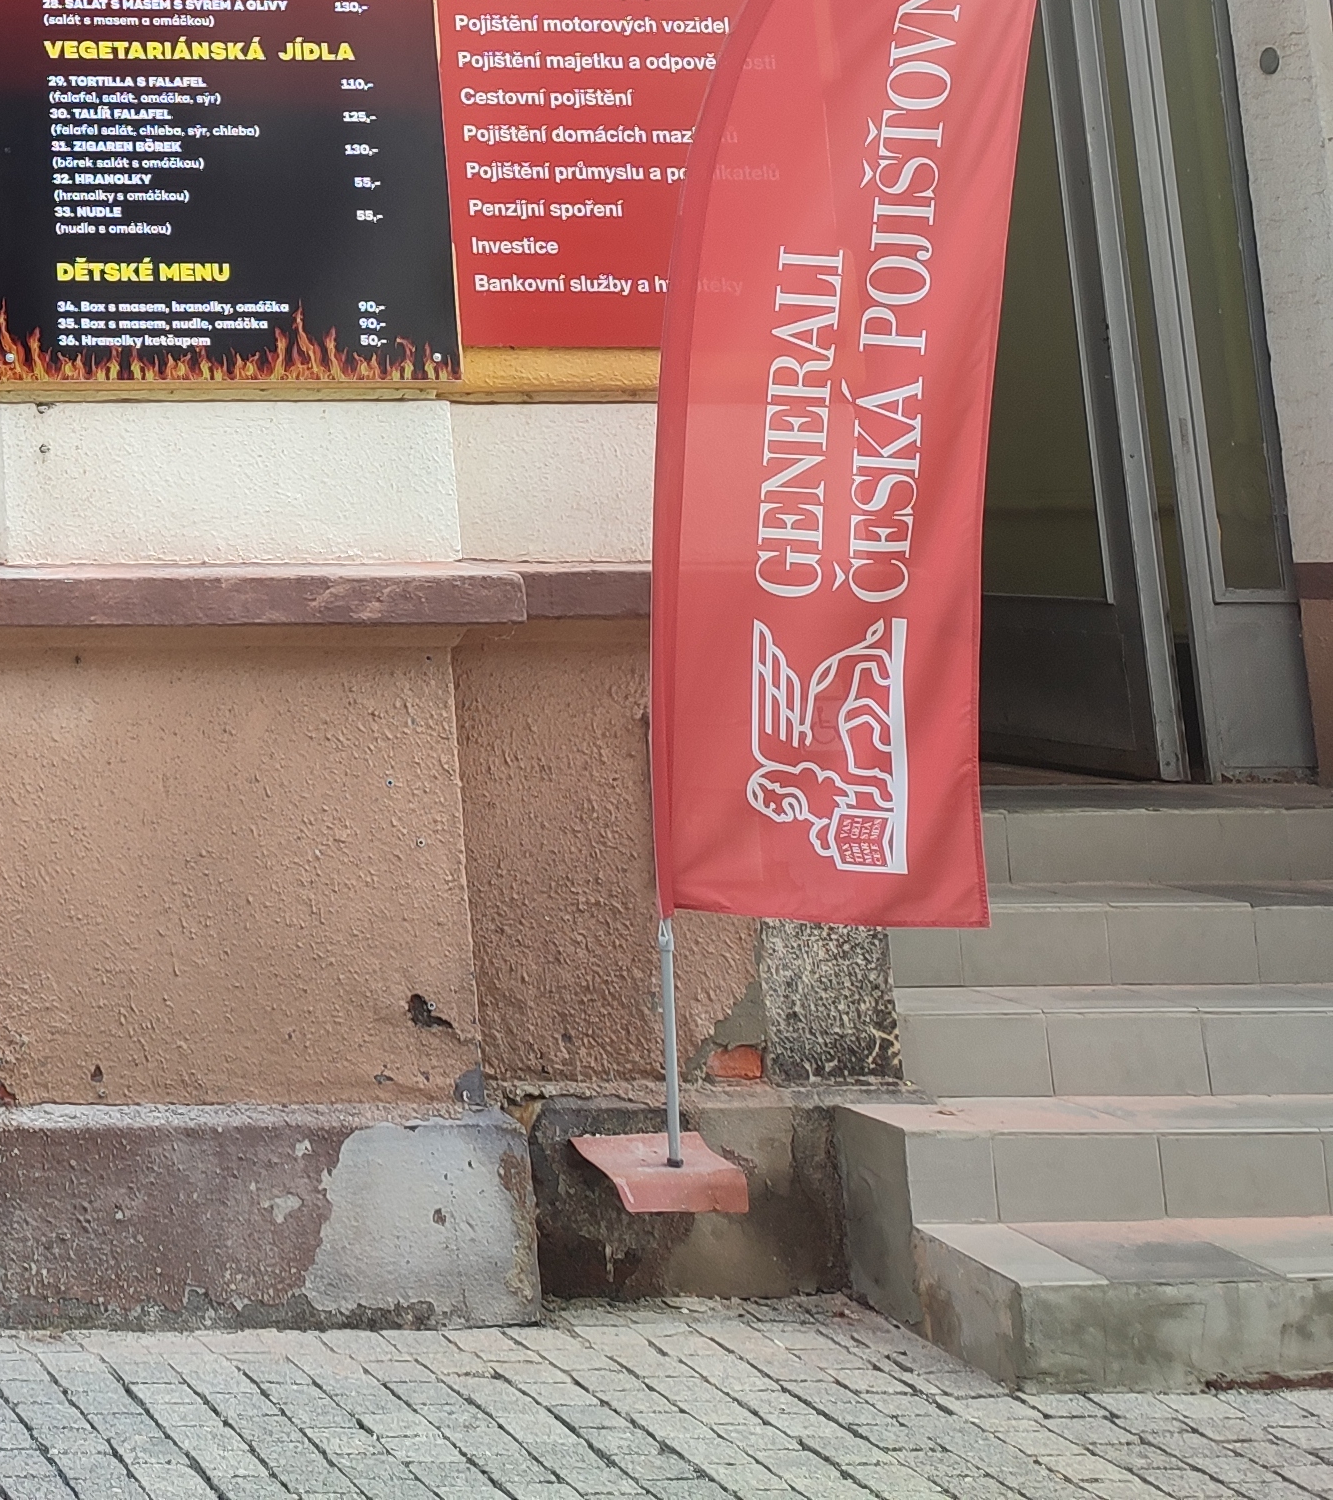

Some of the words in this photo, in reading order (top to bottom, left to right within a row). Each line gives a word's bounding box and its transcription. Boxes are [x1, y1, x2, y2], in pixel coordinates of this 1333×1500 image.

[454, 14, 539, 35] Pojištění
[543, 16, 657, 35] motorových
[661, 17, 730, 34] vozidel
[43, 37, 267, 60] VEGETARIÁNSKÁ
[277, 37, 356, 60] JÍDLA
[457, 52, 542, 71] Pojištění
[545, 53, 624, 71] majetku
[628, 57, 641, 68] a
[460, 88, 546, 106] Cestovní
[549, 89, 633, 108] pojištění
[463, 125, 548, 144] Pojištění
[551, 125, 647, 143] domácích
[51, 174, 73, 184] 32.
[74, 173, 152, 184] HRANOLKY
[465, 161, 550, 182] Pojištění
[554, 162, 644, 183] průmyslu
[648, 168, 662, 179] a
[468, 200, 546, 219] Penzijní
[549, 200, 624, 220] spoření
[471, 237, 559, 253] Investice
[56, 257, 154, 281] DĚTSKÉ
[158, 263, 230, 281] MENU
[474, 274, 566, 291] Bankovní
[569, 274, 633, 295] služby
[637, 280, 650, 292] a
[57, 318, 81, 328] 35.
[80, 318, 106, 328] Box
[118, 321, 170, 330] masem,
[171, 318, 213, 331] nudle,
[214, 317, 269, 328] omáčka
[755, 245, 843, 598] GENERALI
[831, 376, 923, 603] ČESKÁ
